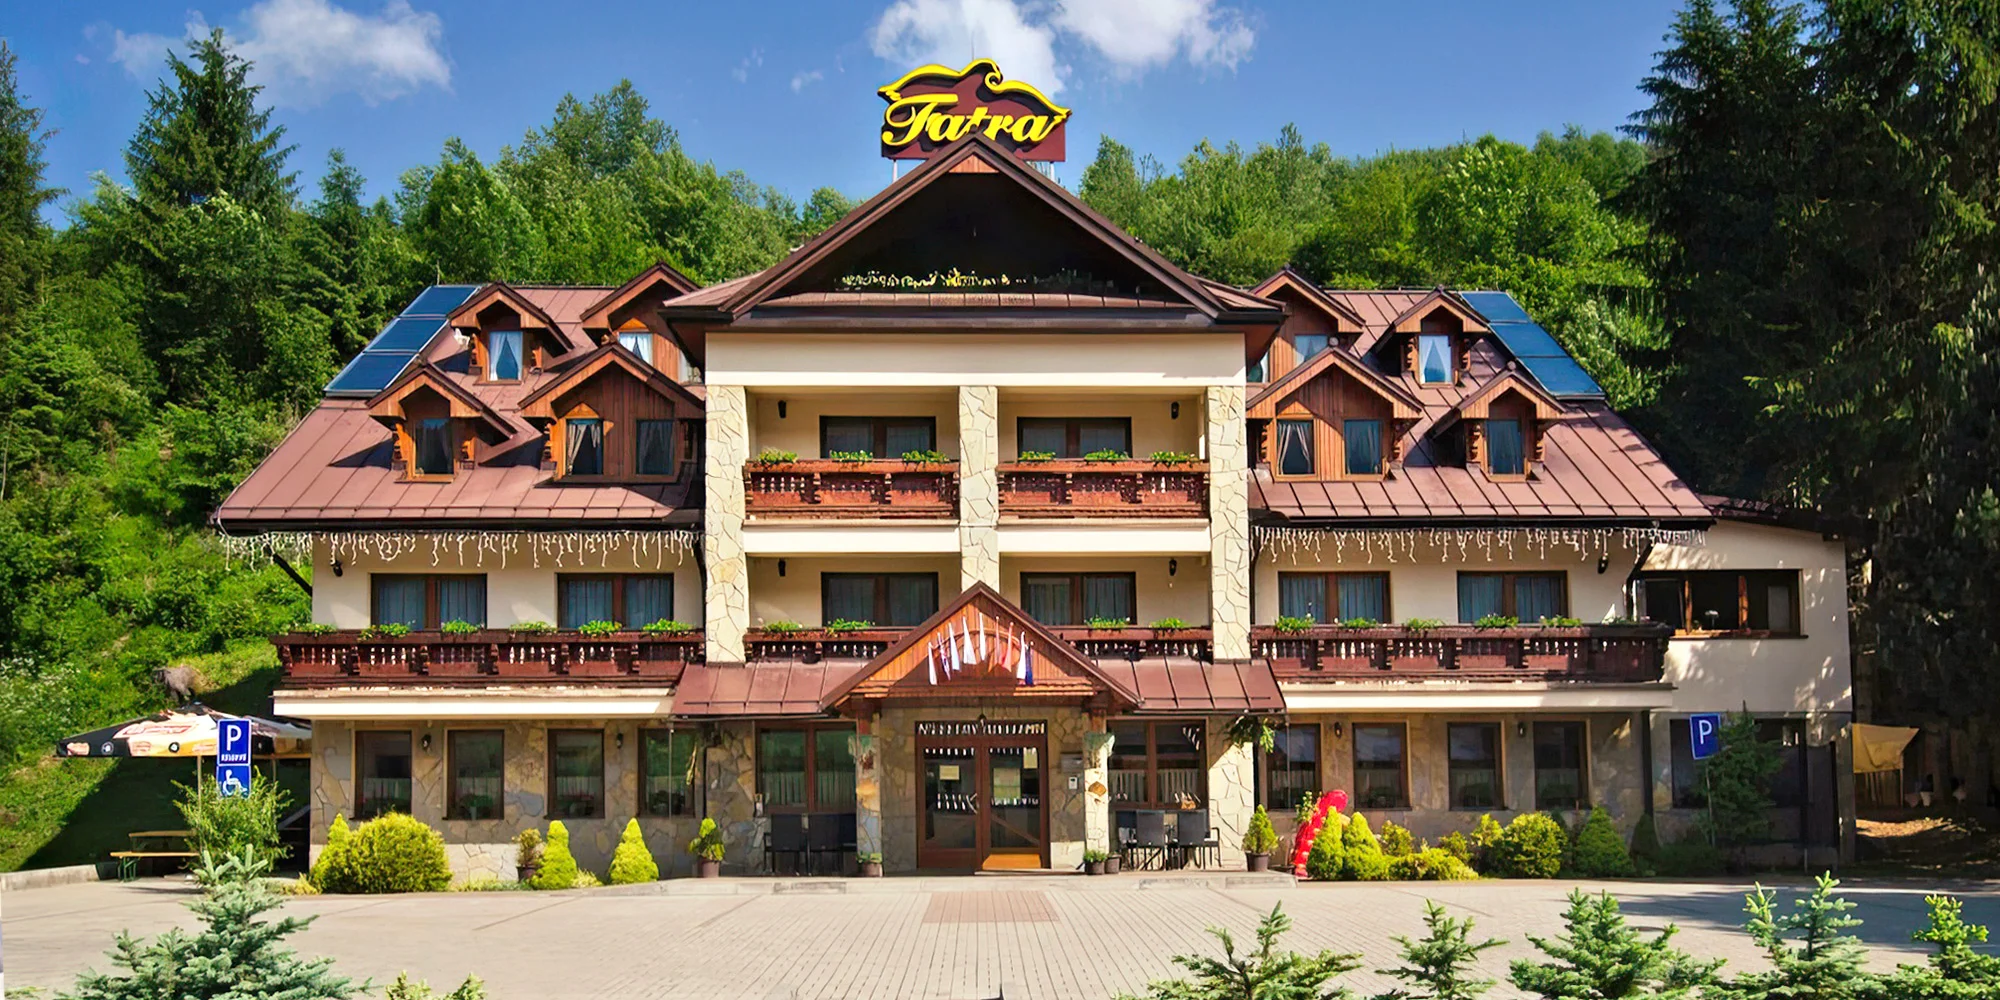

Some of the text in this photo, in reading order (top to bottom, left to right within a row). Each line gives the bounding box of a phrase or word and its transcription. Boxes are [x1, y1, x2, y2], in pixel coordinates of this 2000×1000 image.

[881, 93, 1066, 146] Tatra
[227, 724, 241, 751] P
[1699, 720, 1712, 744] P
